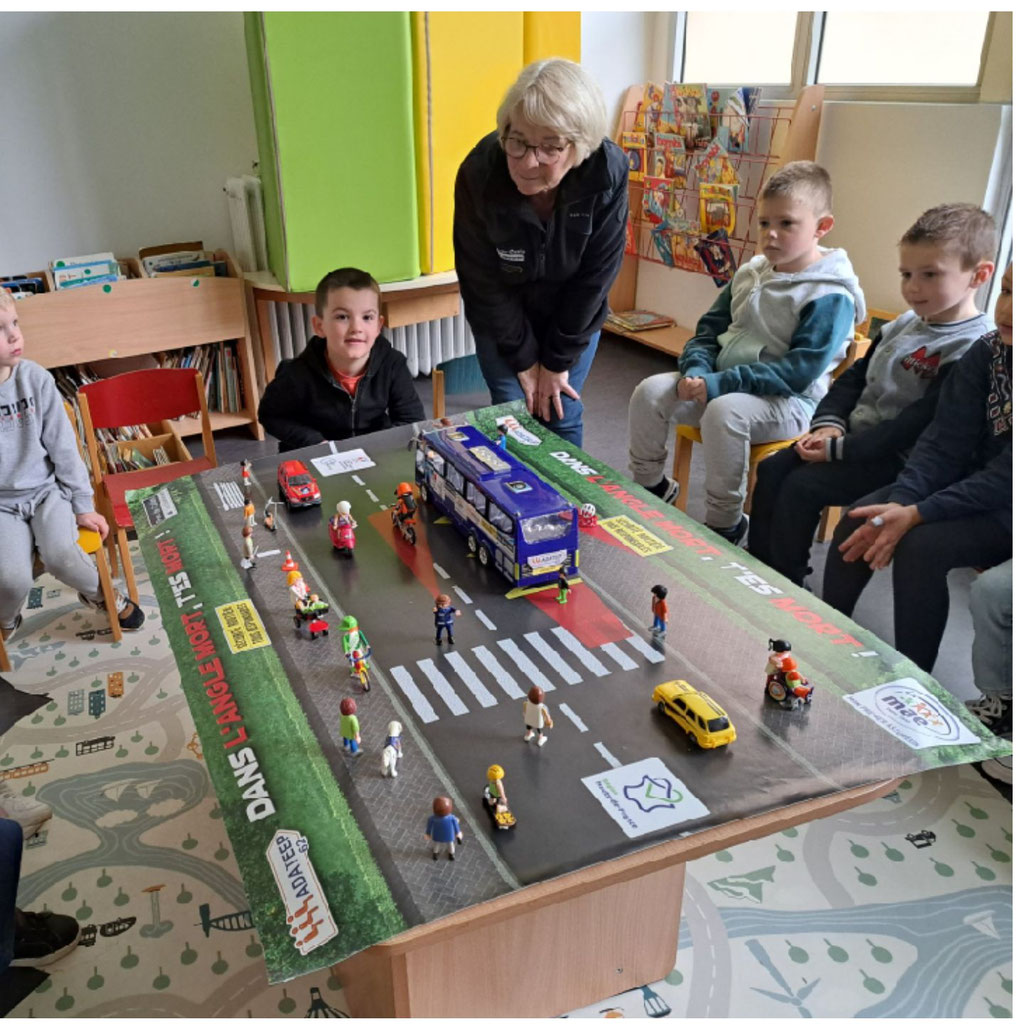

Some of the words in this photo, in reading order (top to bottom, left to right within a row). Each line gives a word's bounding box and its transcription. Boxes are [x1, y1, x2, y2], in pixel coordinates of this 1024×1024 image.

[157, 538, 185, 575] MORT
[549, 451, 600, 475] DANS
[586, 474, 666, 520] L'ANGLE
[720, 562, 783, 595] T'ES
[770, 597, 864, 648] MORT
[168, 571, 196, 608] T'ES
[198, 657, 249, 749] L'ANGLE
[881, 695, 929, 726] mae
[227, 746, 276, 822] DANS
[276, 835, 310, 898] ADATEEP
[296, 838, 309, 853] 62
